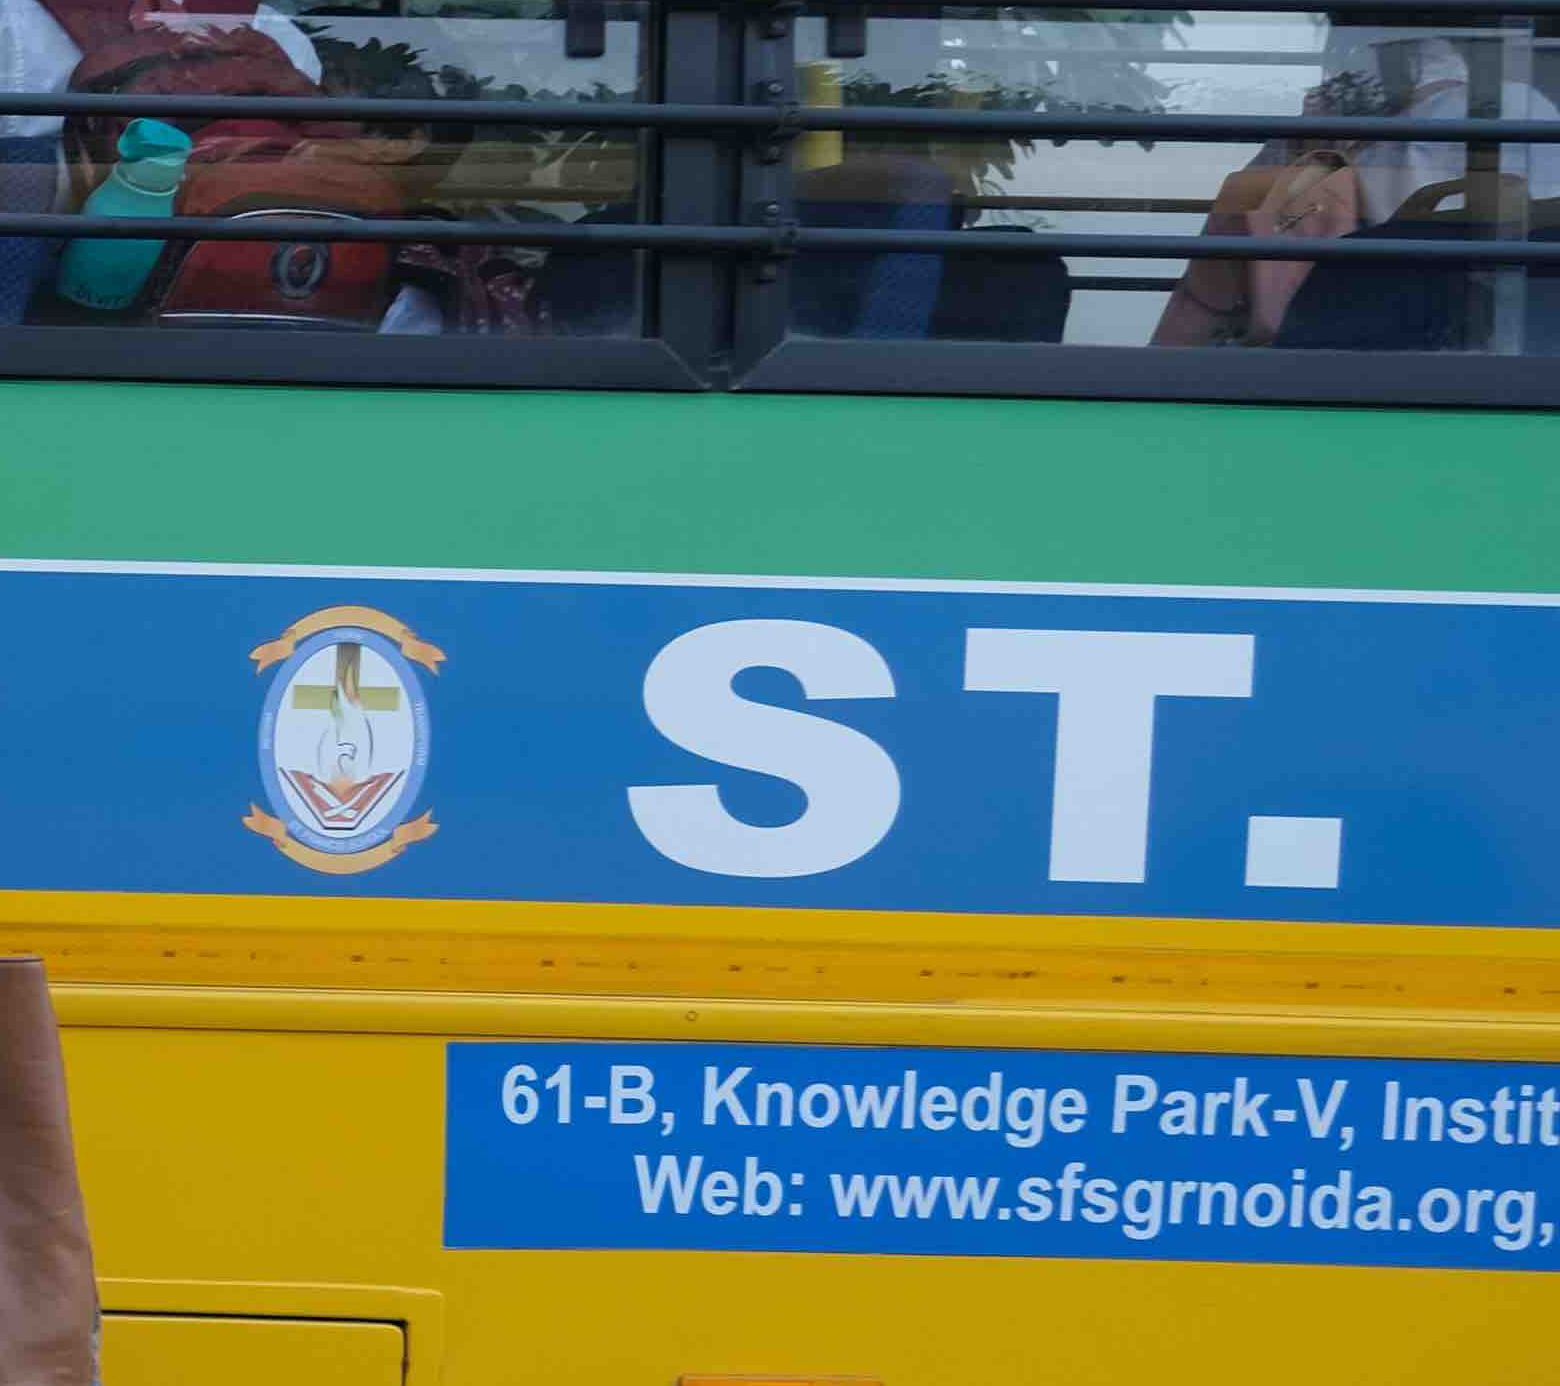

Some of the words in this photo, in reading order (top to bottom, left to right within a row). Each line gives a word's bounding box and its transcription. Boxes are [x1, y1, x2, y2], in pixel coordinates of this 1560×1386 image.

[627, 618, 1342, 889] ST.
[502, 1064, 675, 1137] 61-B,
[703, 1066, 1088, 1149] Knowledge
[1112, 1074, 1354, 1152] Park-V,
[1382, 1080, 1560, 1146] Instit
[634, 1155, 805, 1217] Web:
[831, 1162, 1554, 1252] www.sfsgrnoida.org,
